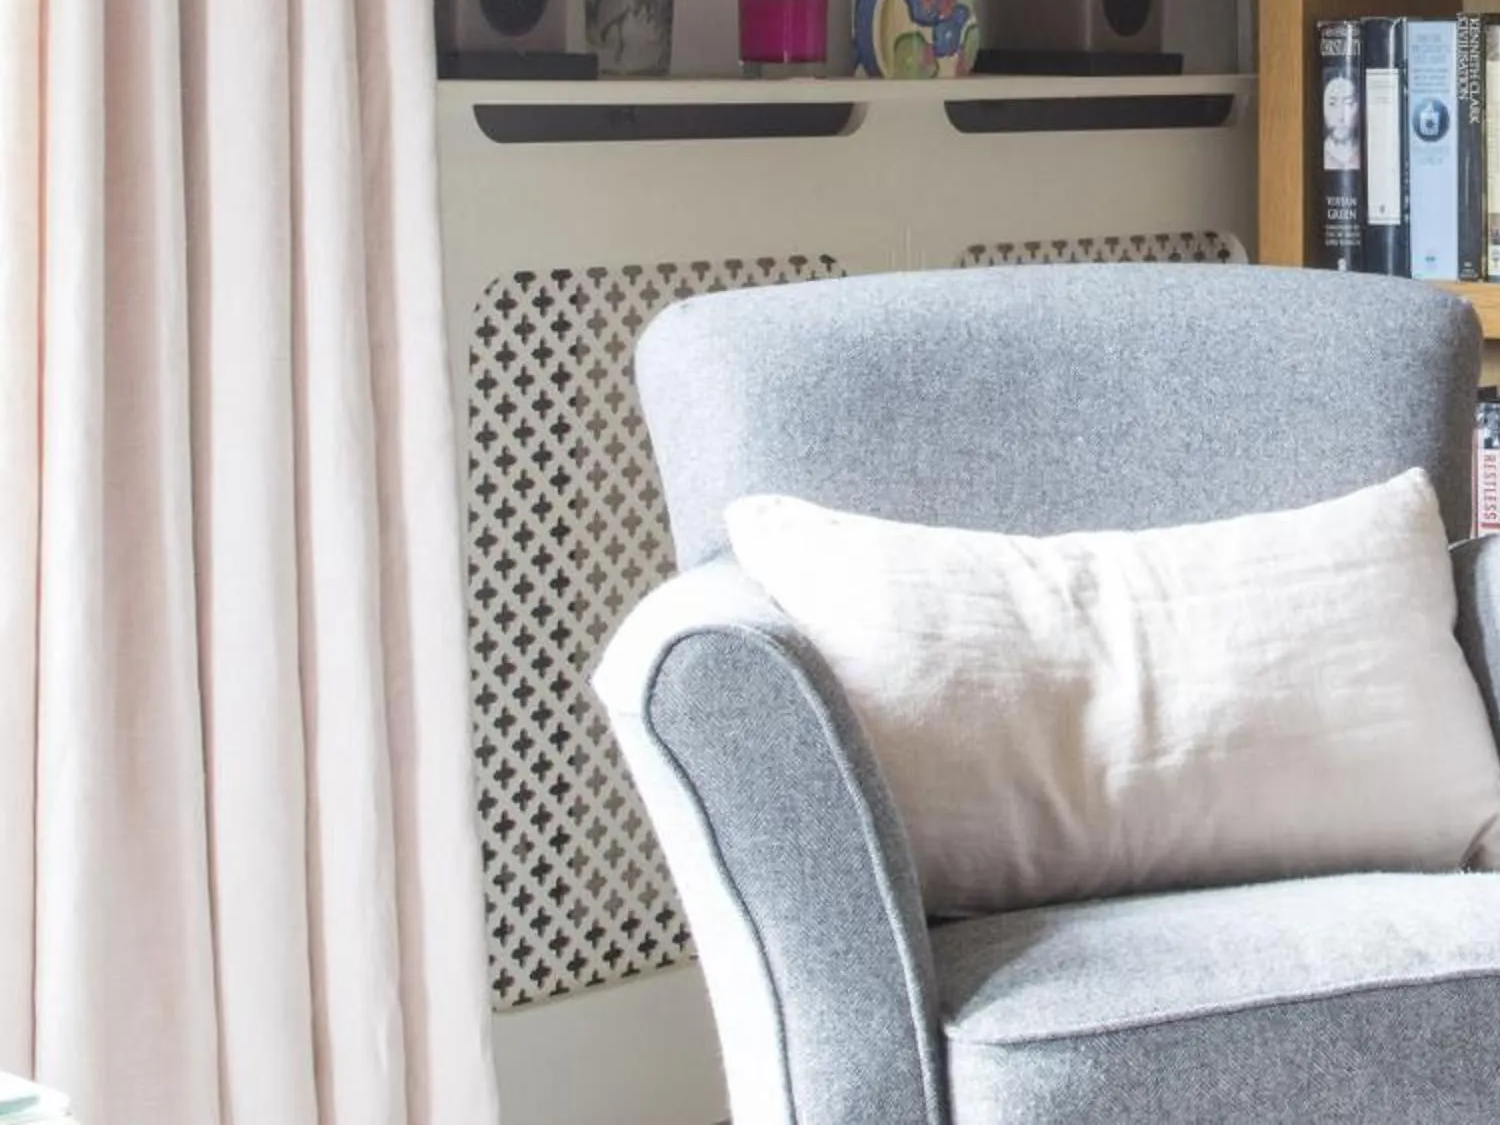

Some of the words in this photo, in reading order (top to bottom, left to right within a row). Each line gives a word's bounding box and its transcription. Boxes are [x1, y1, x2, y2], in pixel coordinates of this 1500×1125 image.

[1469, 17, 1480, 80] KENNETH
[1470, 82, 1480, 124] CLARK
[1483, 453, 1498, 522] RESTLESS
